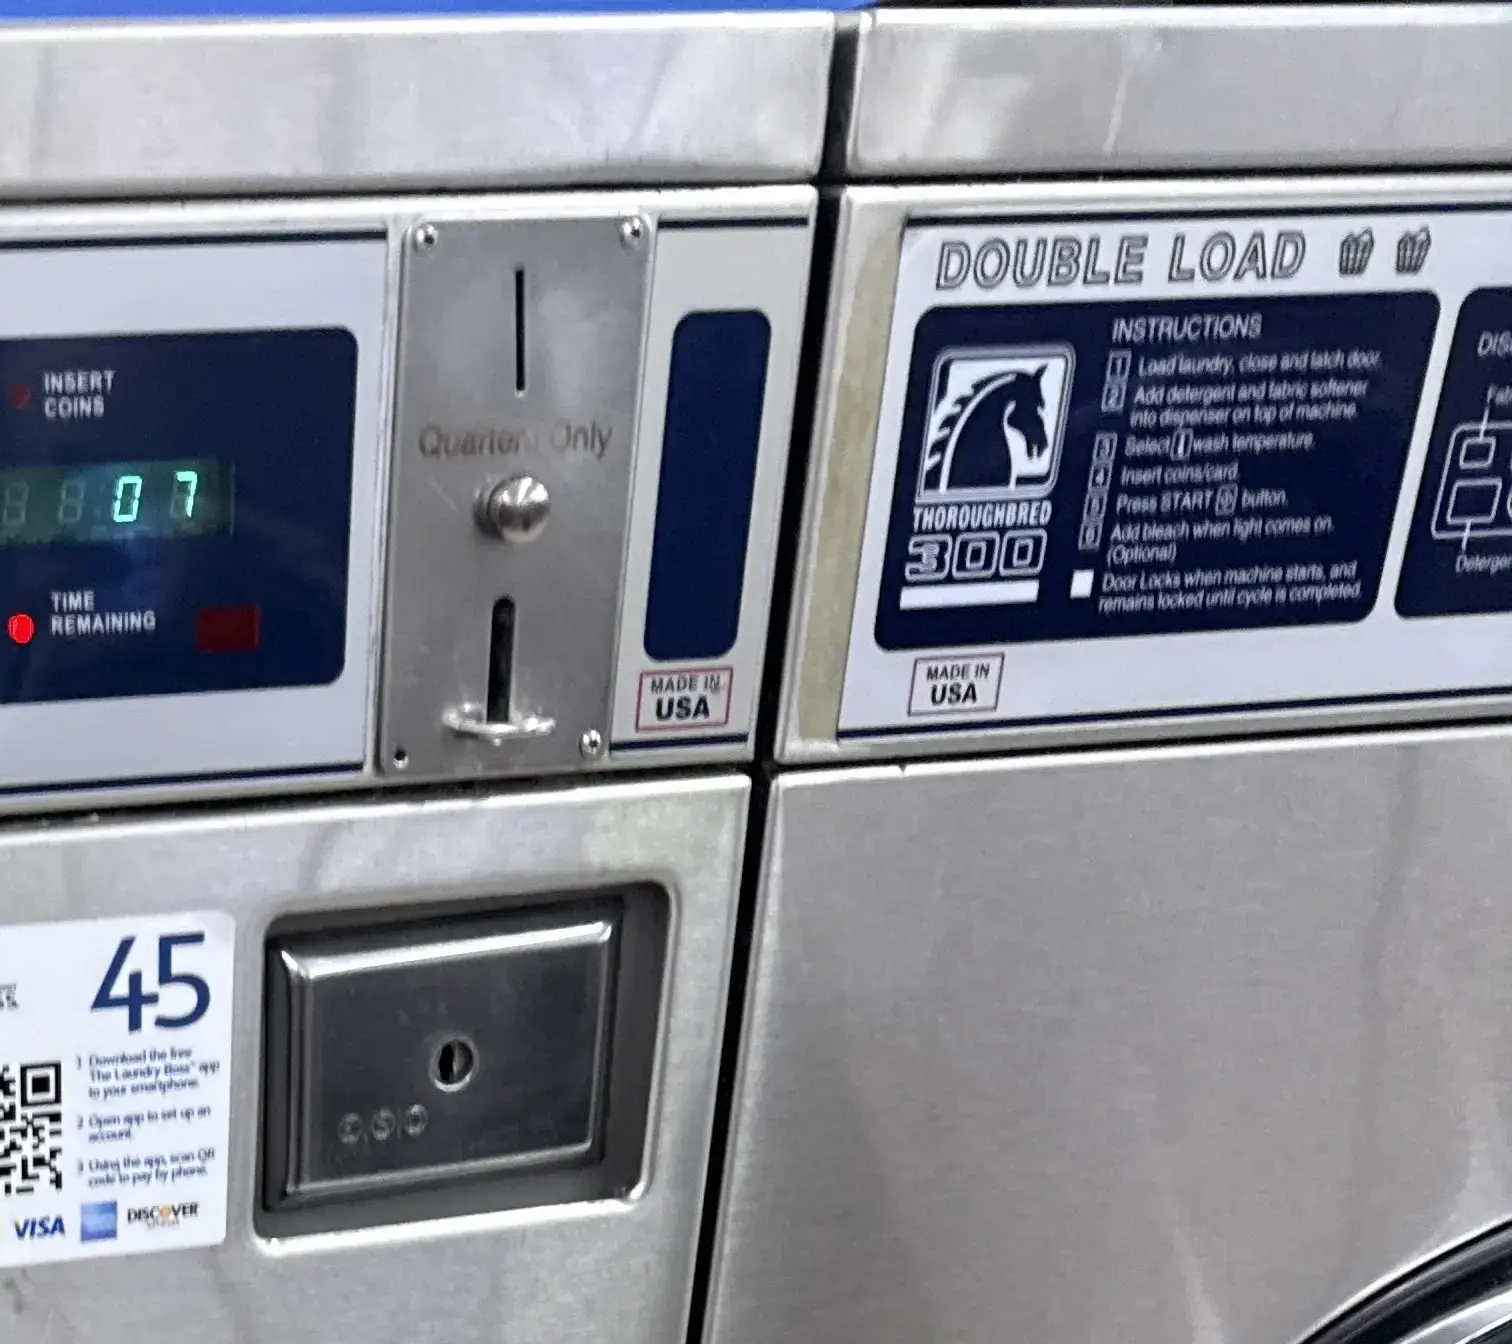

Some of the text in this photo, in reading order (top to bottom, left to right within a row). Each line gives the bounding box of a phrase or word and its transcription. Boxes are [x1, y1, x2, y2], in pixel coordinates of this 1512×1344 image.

[935, 229, 1307, 290] DOUBLE LOAD
[1112, 313, 1262, 343] INSTRUCTIONS
[1139, 356, 1176, 377] Load
[1239, 352, 1277, 373] close
[1280, 351, 1308, 371] and
[44, 369, 116, 396] INSERT
[1134, 378, 1368, 406] Add detergent and fabric softener
[44, 395, 105, 420] COINS
[1130, 407, 1157, 427] into
[1160, 405, 1230, 429] dispenser
[1232, 405, 1251, 424] on
[1254, 403, 1276, 426] top
[1279, 402, 1294, 421] of
[552, 420, 613, 461] Only
[1124, 436, 1170, 457] Select
[1193, 433, 1229, 452] wash
[1120, 465, 1162, 486] Insert
[113, 470, 198, 523] 07
[1116, 494, 1157, 515] Press
[1161, 490, 1214, 512] START
[913, 500, 1052, 532] THOROUGHBRED
[1110, 523, 1140, 543] Add
[1142, 521, 1189, 542] bleach
[1192, 519, 1230, 539] when
[1233, 517, 1262, 543] light
[1265, 516, 1310, 535] comes
[905, 528, 1048, 582] 300
[1107, 541, 1177, 568] (Optional)
[1102, 571, 1138, 593] Door
[1140, 569, 1181, 590] Locks
[1184, 567, 1222, 588] when
[1224, 565, 1283, 587] machine
[1330, 560, 1358, 581] and
[50, 589, 95, 614] TIME
[1098, 594, 1155, 615] remains
[1157, 591, 1203, 611] locked
[1206, 588, 1235, 608] until
[1237, 587, 1273, 610] cycle
[1275, 585, 1286, 604] is
[50, 609, 156, 636] REMAINING
[651, 673, 720, 694] MADE IN
[927, 662, 990, 681] MADE IN
[932, 681, 977, 706] USA
[656, 695, 709, 721] USA
[90, 930, 211, 1034] 45
[89, 1049, 146, 1067] Download
[150, 1047, 167, 1062] the
[115, 1065, 160, 1081] Laundry
[89, 1112, 120, 1130] Open
[127, 1202, 199, 1225] DISCOVER
[14, 1214, 66, 1241] VISA
